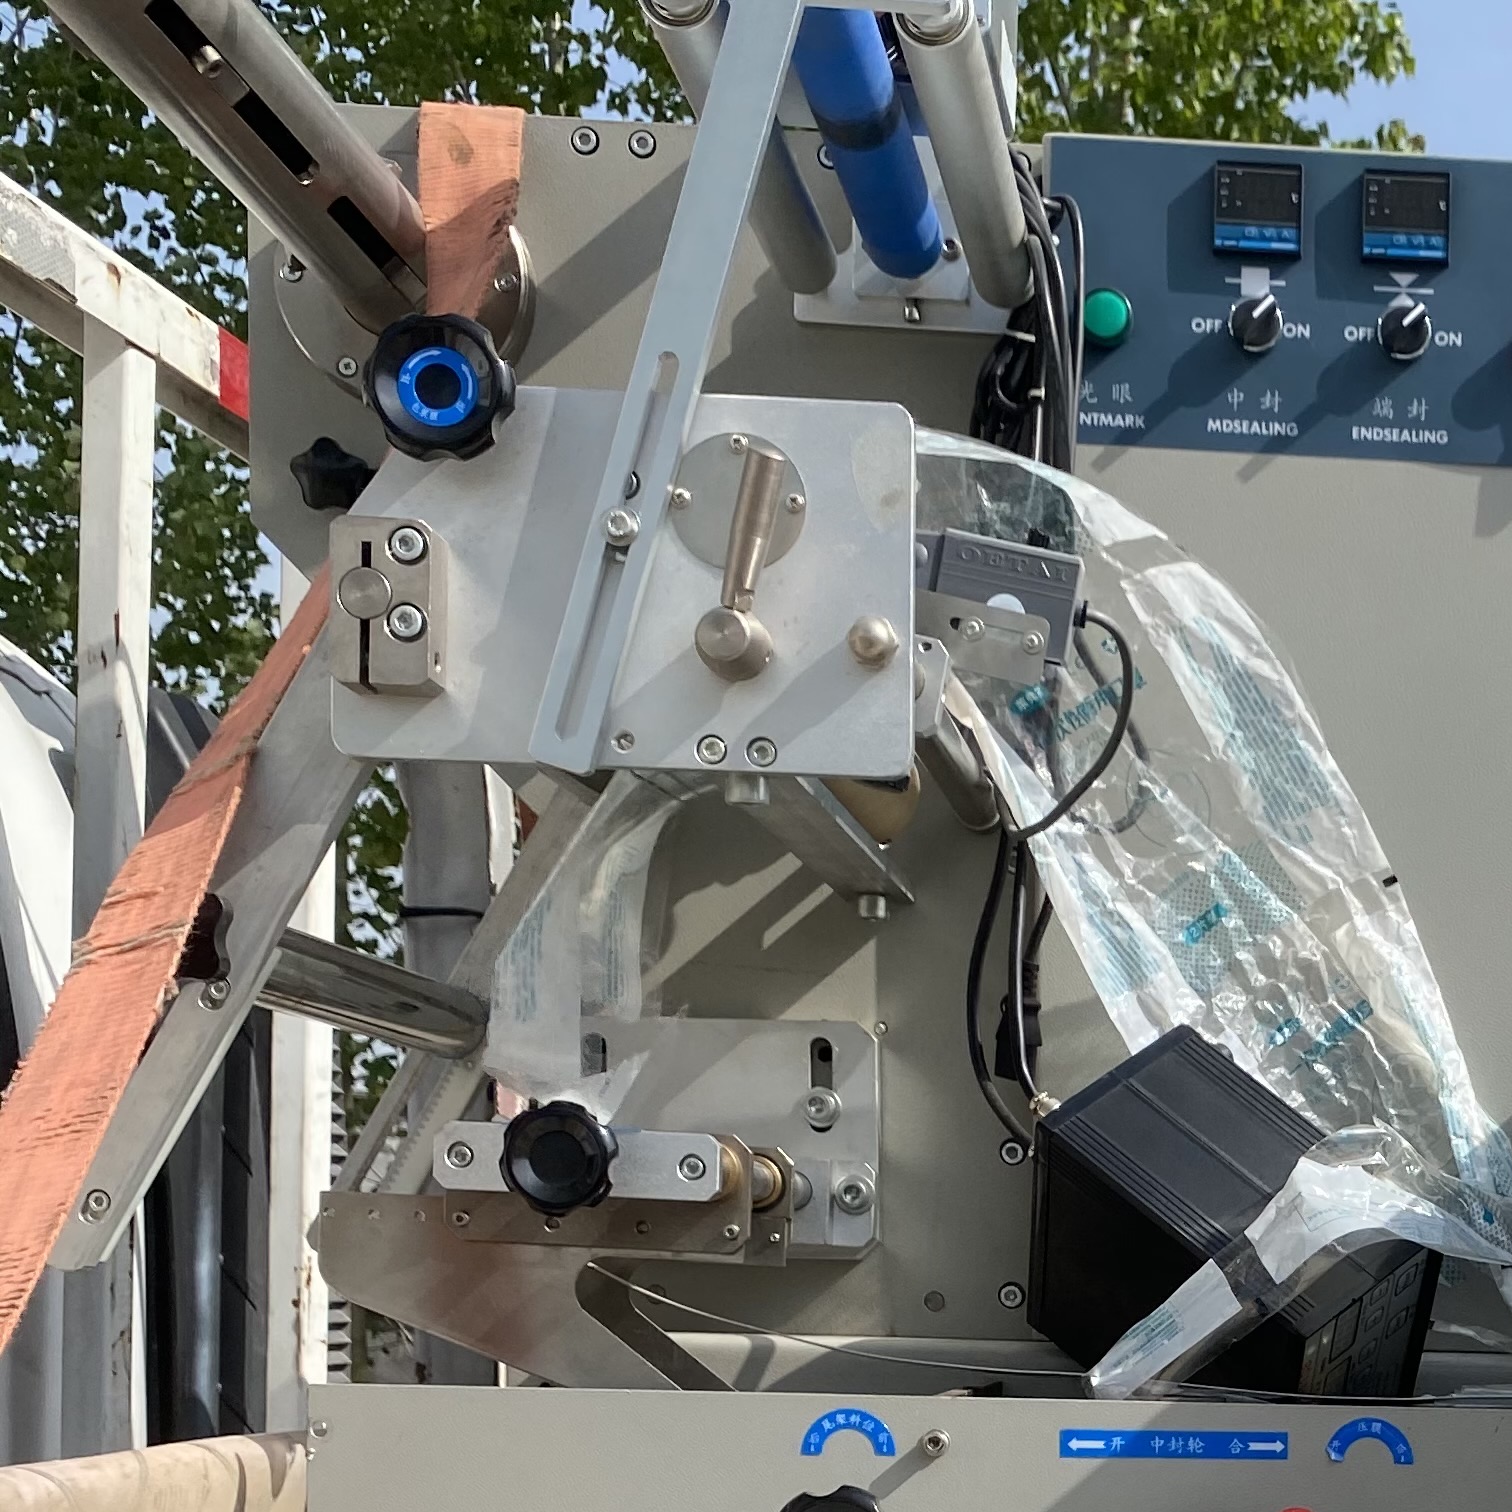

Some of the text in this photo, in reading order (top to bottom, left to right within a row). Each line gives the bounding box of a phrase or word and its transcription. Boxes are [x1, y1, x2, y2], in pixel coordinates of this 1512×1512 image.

[1191, 317, 1311, 339] OFF ON
[1343, 325, 1463, 348] OFF ON
[1227, 387, 1282, 414] 中封
[1372, 396, 1429, 422] 端封
[1079, 411, 1145, 430] NTMARK
[1206, 417, 1299, 437] MDSEALING
[1351, 425, 1449, 445] ENDSEALING
[1110, 1436, 1245, 1455] 开 中封轮 合
